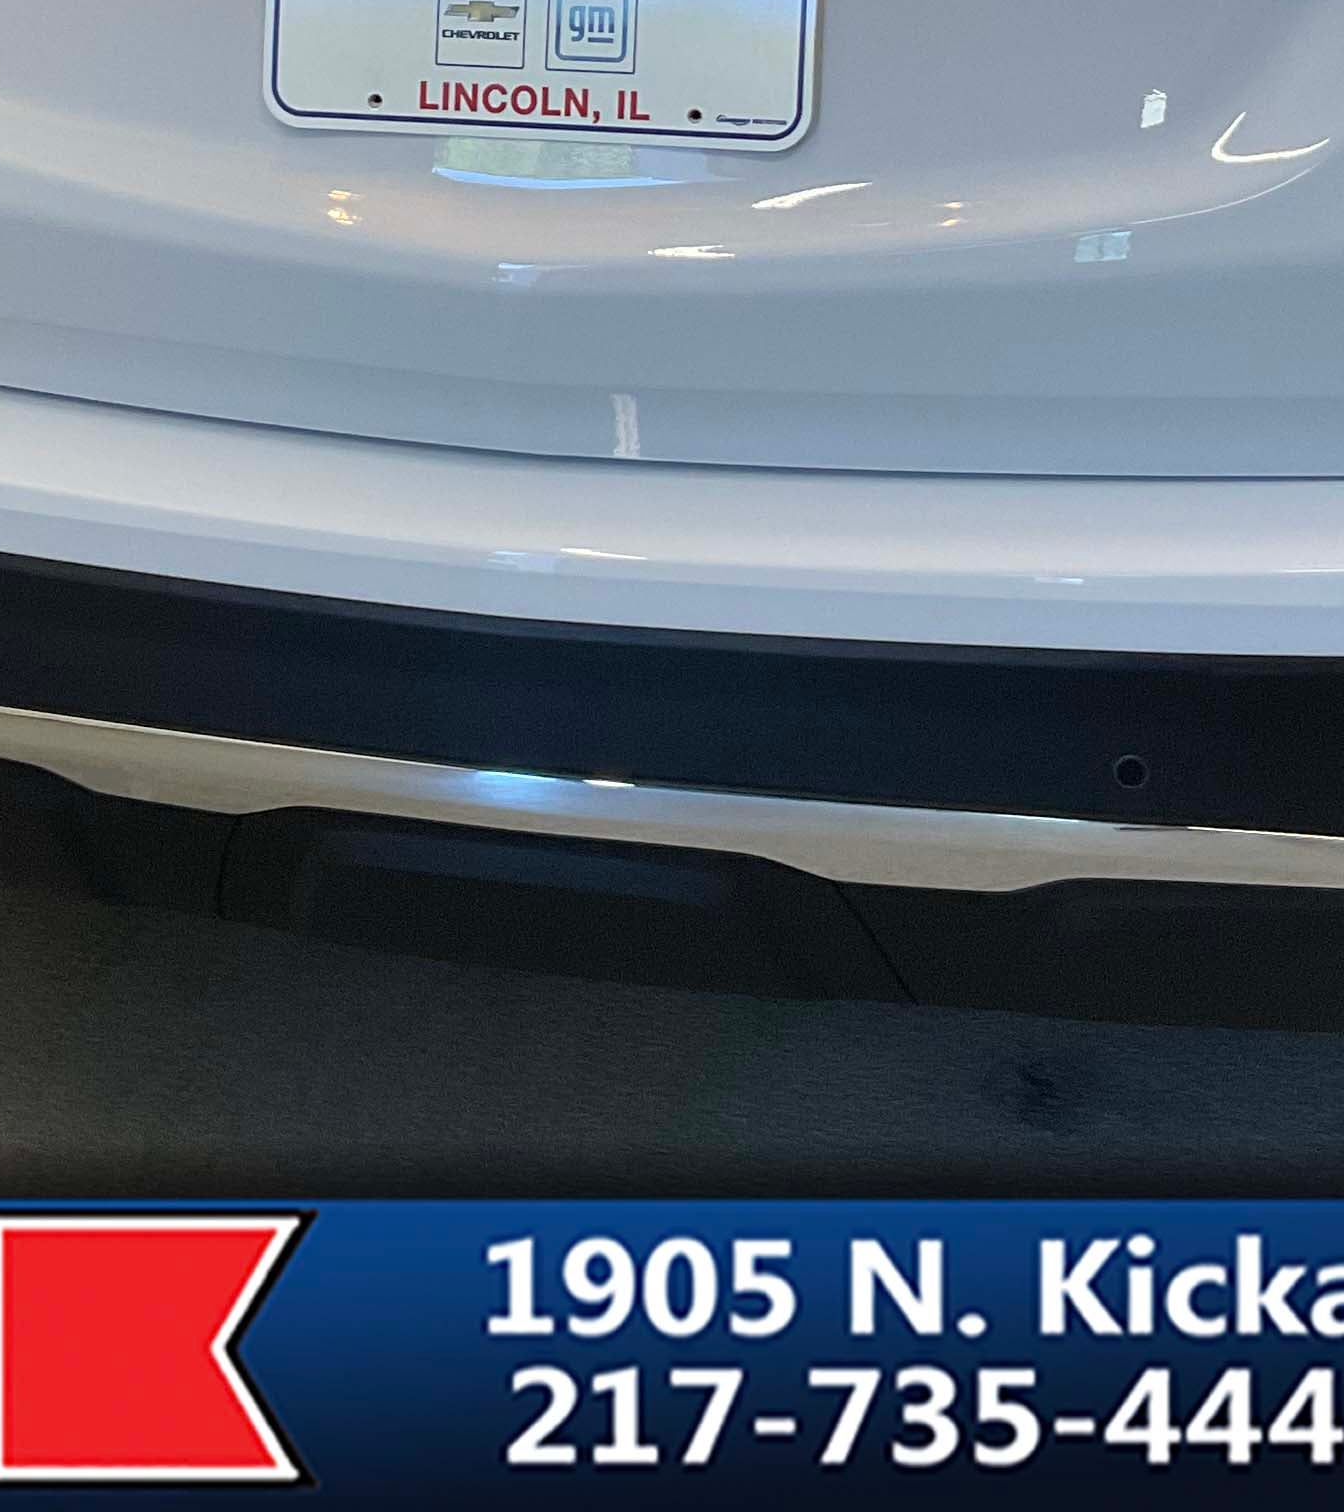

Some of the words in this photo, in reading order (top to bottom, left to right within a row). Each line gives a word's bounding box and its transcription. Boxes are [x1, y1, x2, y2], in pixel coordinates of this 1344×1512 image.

[441, 28, 520, 42] CHEVROLET
[418, 81, 601, 124] LINCOLN,
[617, 91, 651, 121] IL
